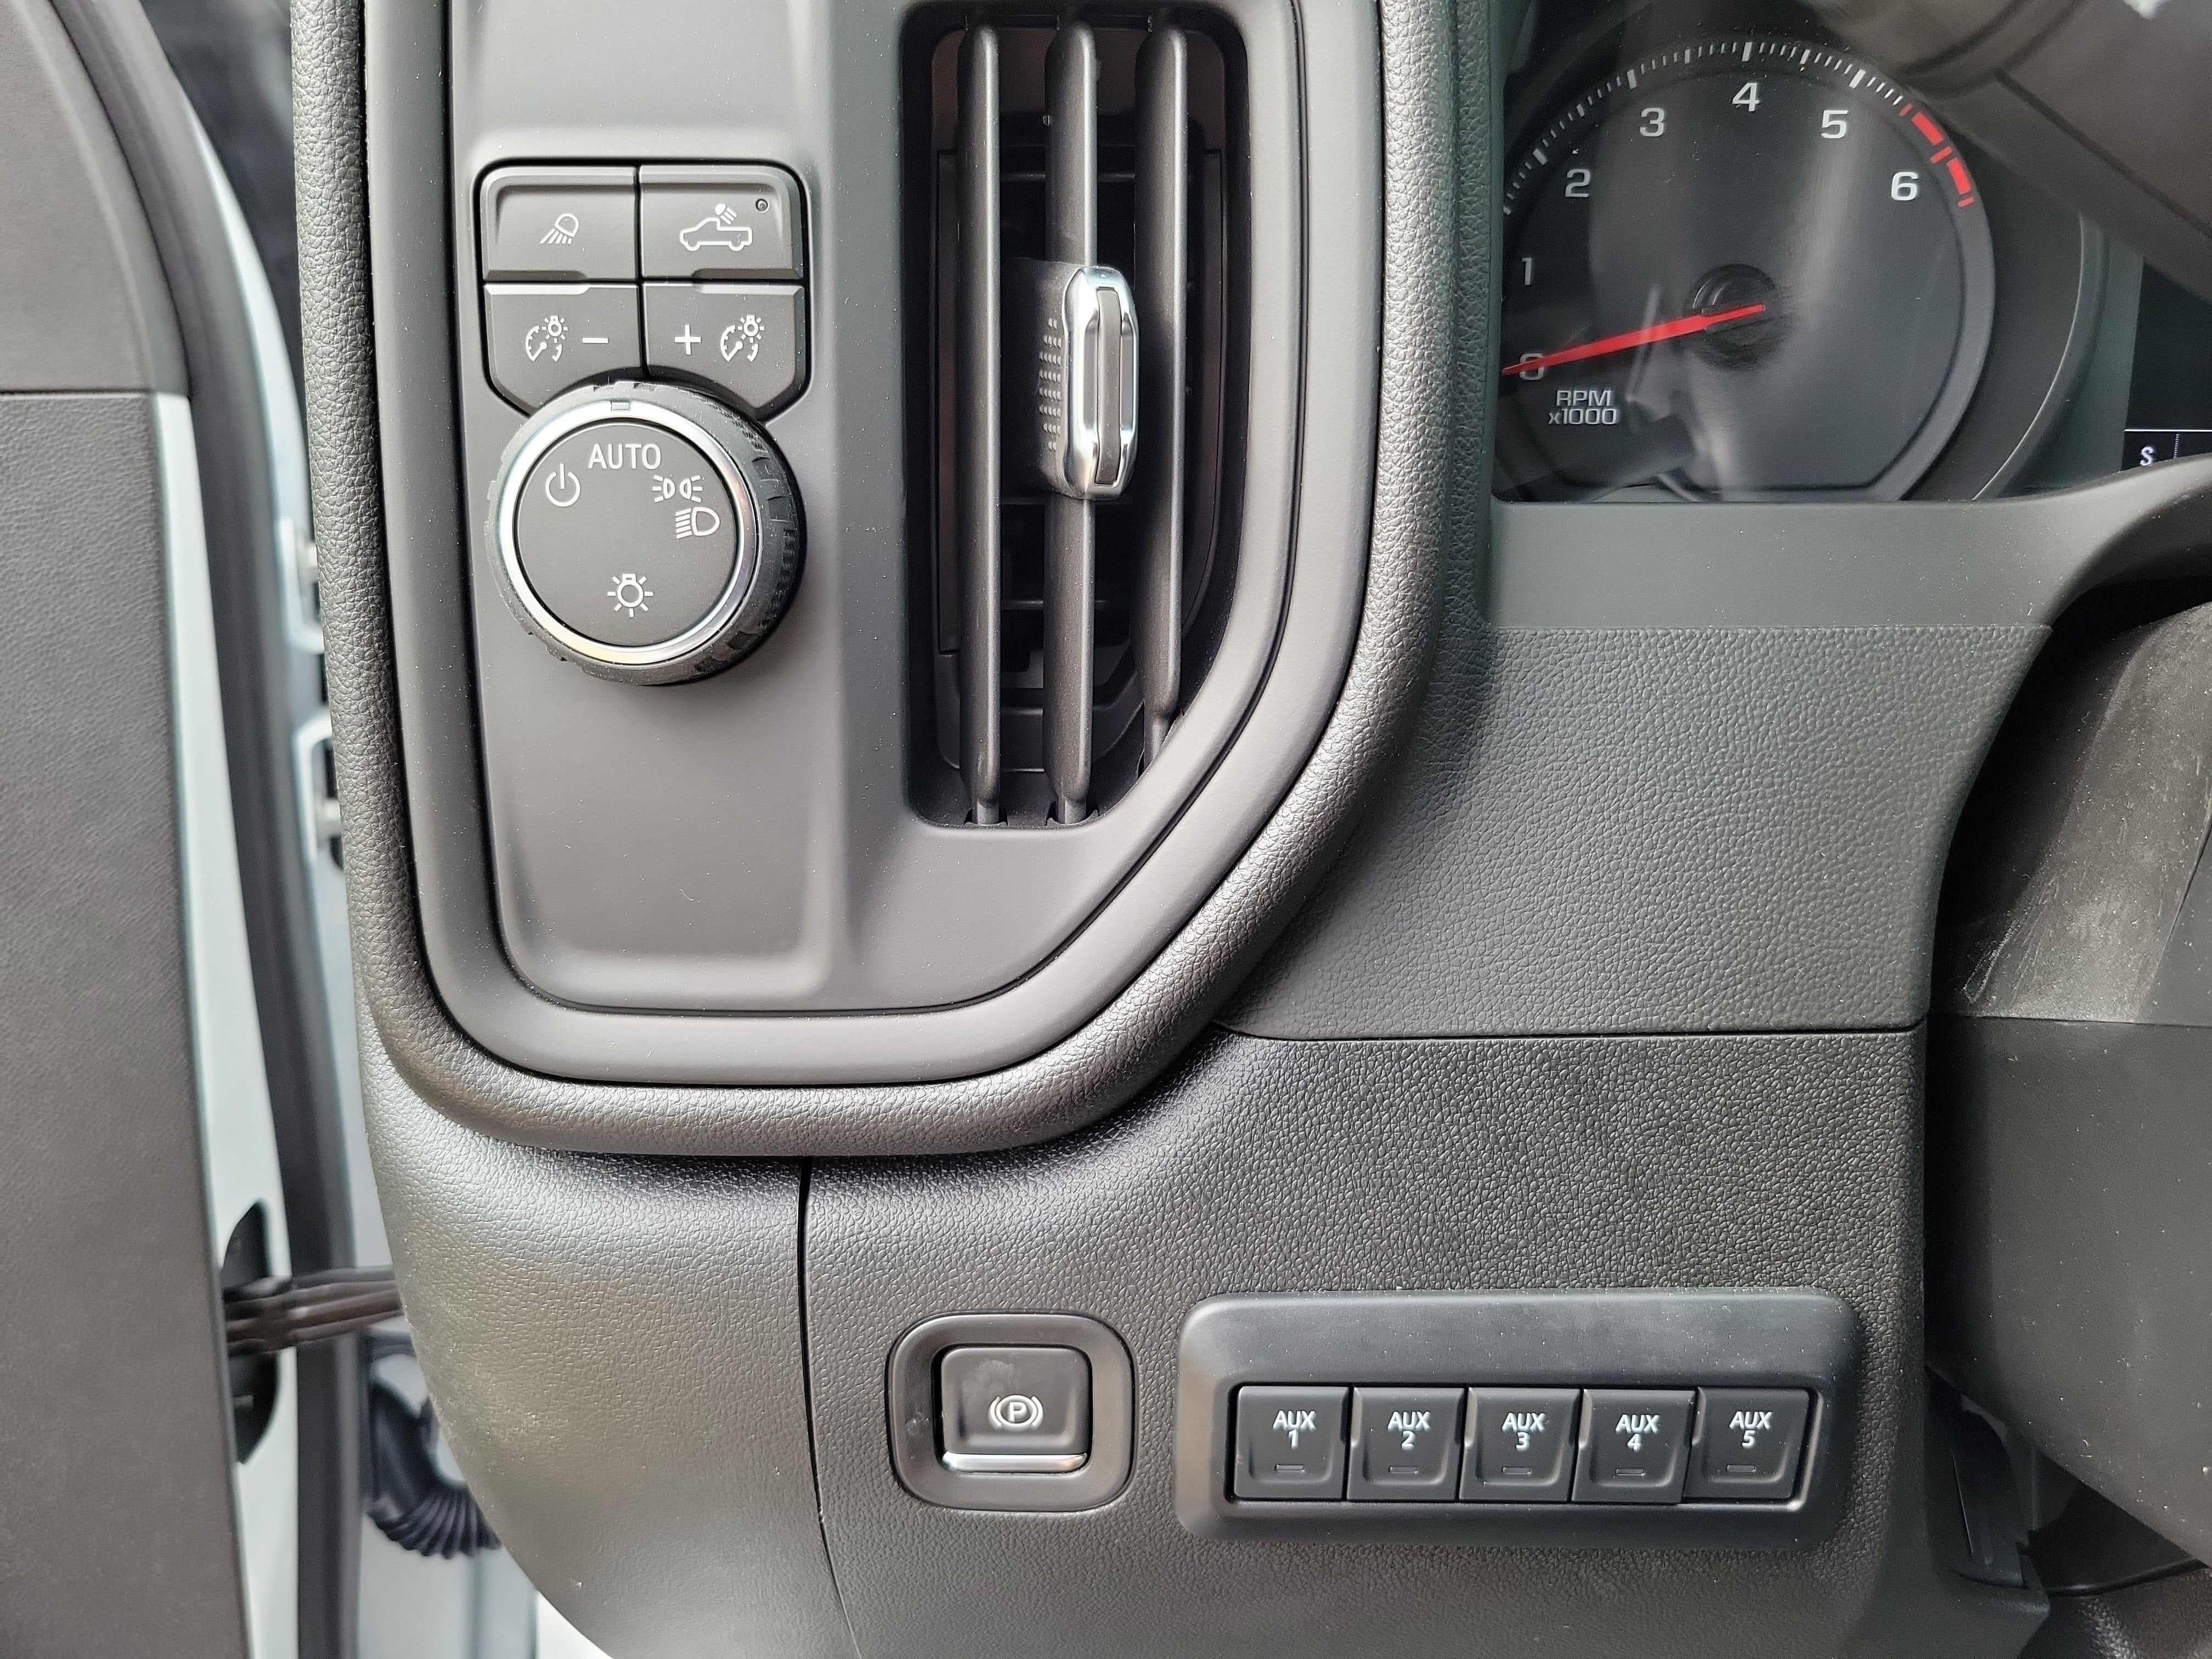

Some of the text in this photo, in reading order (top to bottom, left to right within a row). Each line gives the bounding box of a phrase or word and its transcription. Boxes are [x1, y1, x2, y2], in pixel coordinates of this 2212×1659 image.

[1732, 82, 1760, 112] 4
[1639, 107, 1665, 137] 3
[1821, 110, 1848, 139] 5
[1565, 168, 1591, 198] 2
[1891, 171, 1918, 201] 6
[1522, 257, 1533, 285] 1
[1519, 353, 1544, 381] 0
[1556, 389, 1613, 407] RPM
[1549, 407, 1619, 425] x1000
[588, 443, 661, 470] AUTO
[2140, 446, 2154, 466] S
[1009, 1401, 1027, 1423] P
[1273, 1410, 1316, 1430] AUX
[1387, 1411, 1430, 1430] AUX
[1729, 1411, 1773, 1430] AUX
[1502, 1413, 1545, 1432] AUX
[1615, 1414, 1660, 1434] AUX
[1288, 1430, 1299, 1449] 1
[1401, 1430, 1415, 1449] 2
[1516, 1431, 1530, 1451] 3
[1627, 1433, 1641, 1451] 4
[1742, 1430, 1756, 1448] 5
